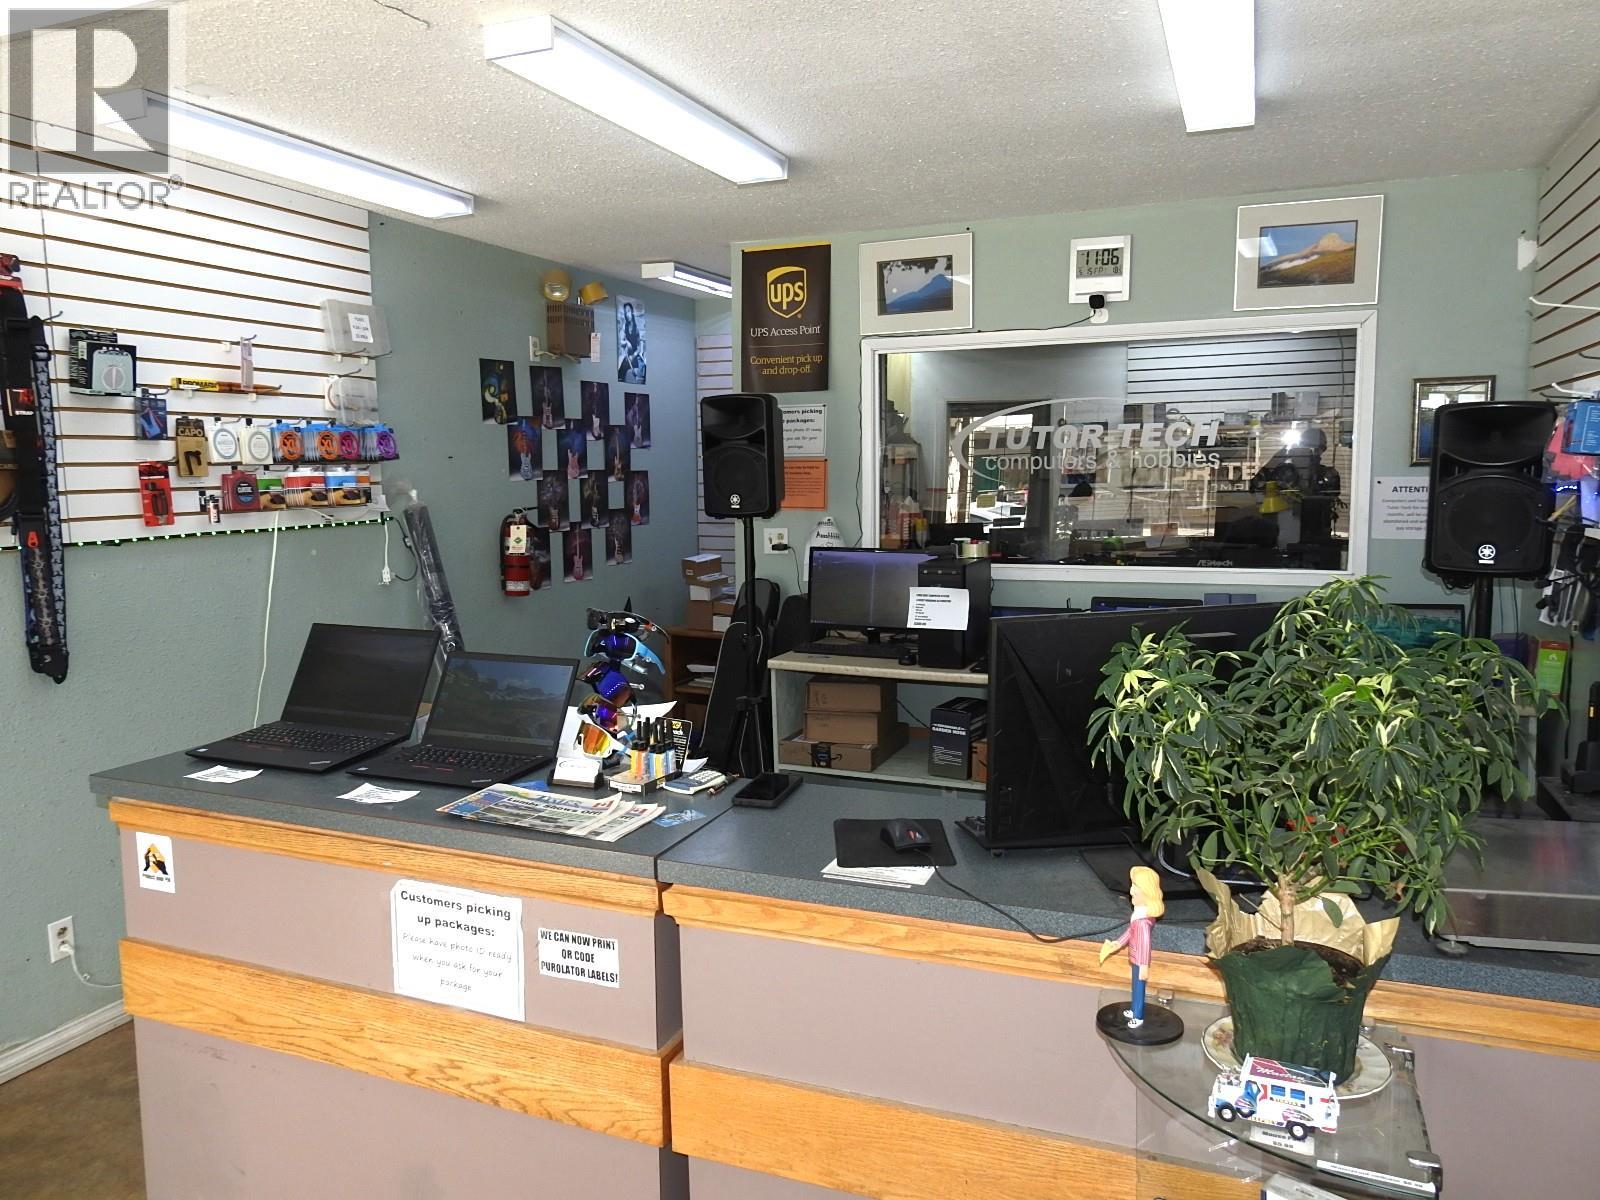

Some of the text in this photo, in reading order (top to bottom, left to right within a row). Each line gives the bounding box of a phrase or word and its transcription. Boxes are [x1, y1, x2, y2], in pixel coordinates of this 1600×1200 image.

[1085, 247, 1120, 266] 11:06
[770, 280, 804, 310] ups
[750, 324, 821, 337] UPS Access Point
[750, 353, 823, 366] Convenient pick up
[761, 364, 811, 376] and drop-off
[801, 407, 823, 415] picking
[178, 427, 203, 438] CAPO
[985, 449, 1220, 473] computers & hobbies
[1391, 485, 1428, 493] ATTENTI
[400, 890, 511, 921] Customers picking
[417, 914, 495, 937] up packages:
[402, 932, 427, 944] Please
[429, 936, 447, 949] have
[450, 942, 473, 954] photo
[488, 950, 512, 963] ready
[540, 929, 616, 951] WE CAN NOW PRINT
[561, 948, 595, 963] QR CODE
[436, 958, 451, 968] you
[483, 967, 503, 979] your
[540, 961, 618, 983] PUROLATOR LABELS!
[440, 978, 472, 992] package
[1262, 1130, 1287, 1139] Mouse
